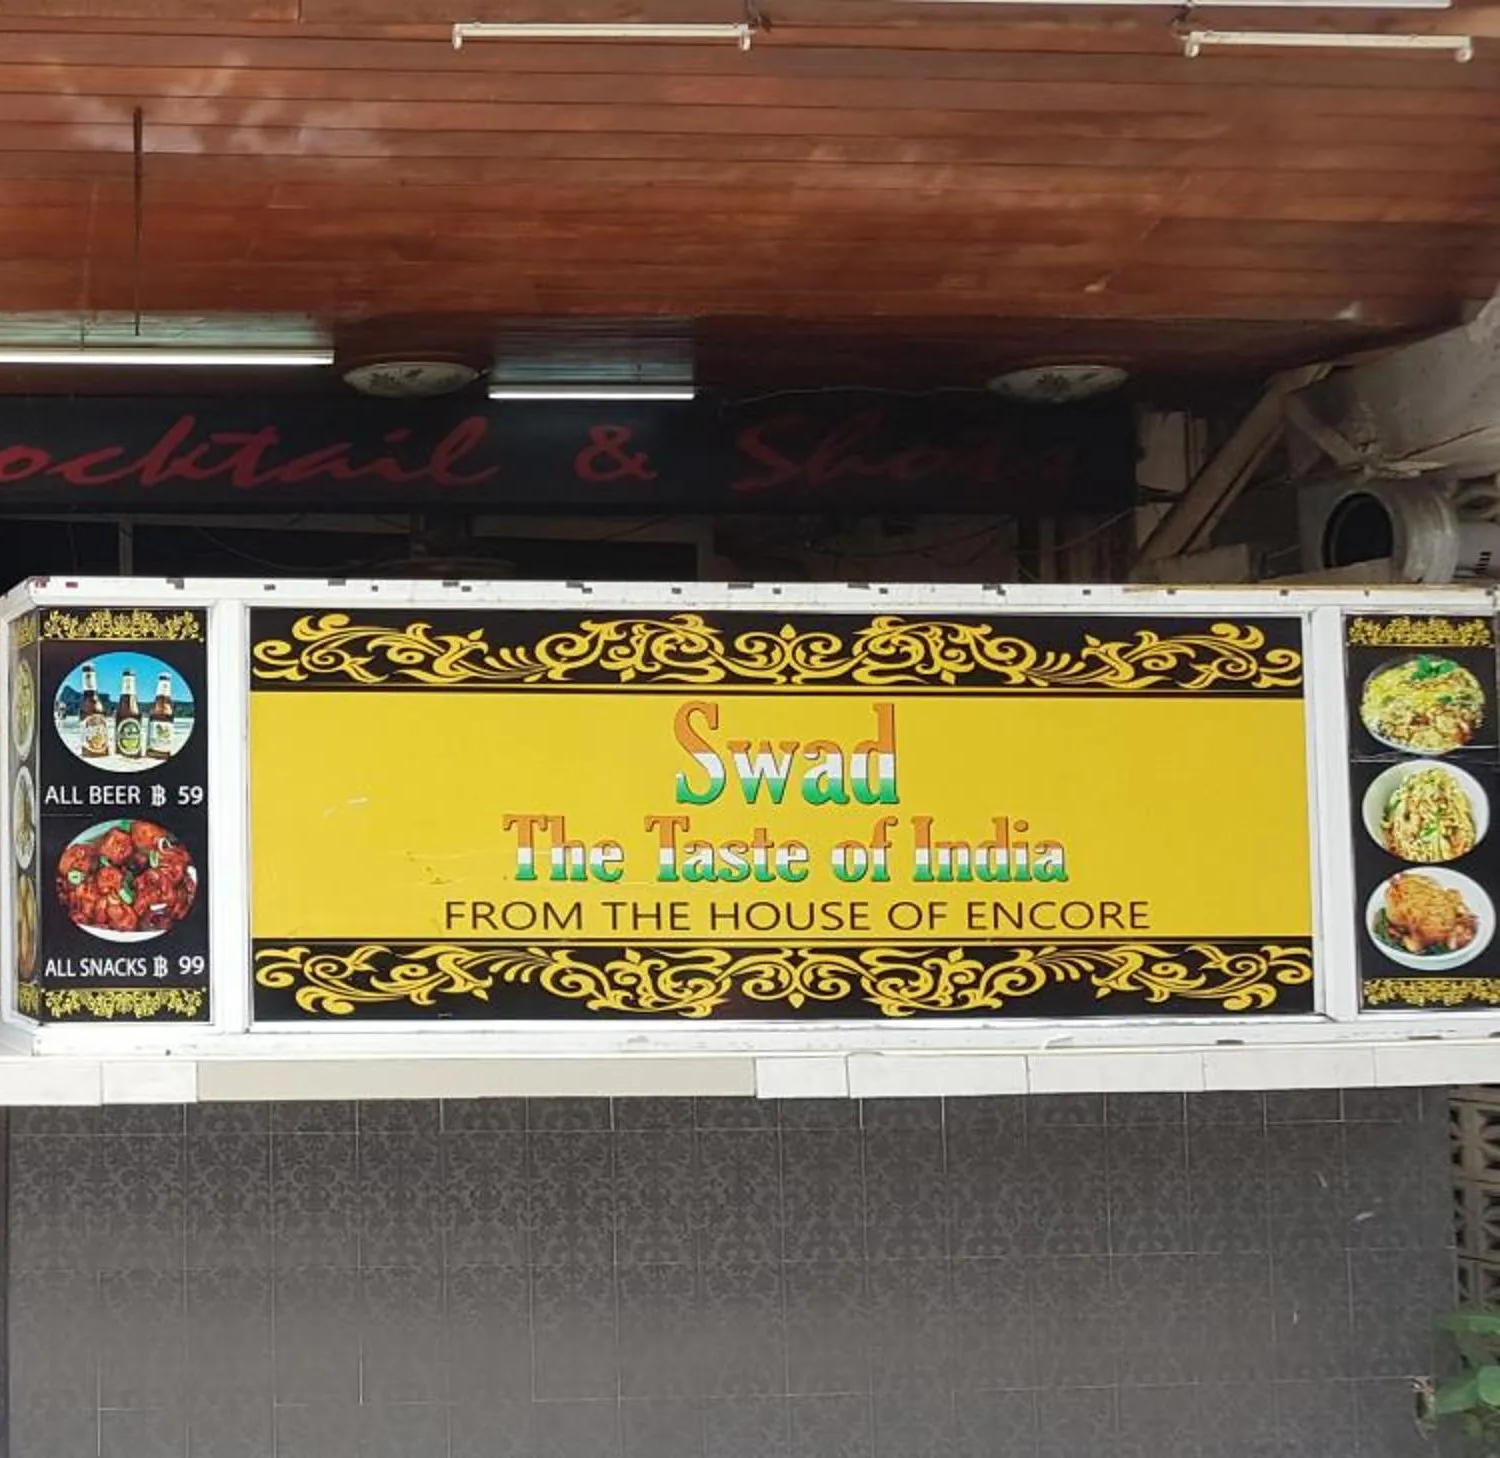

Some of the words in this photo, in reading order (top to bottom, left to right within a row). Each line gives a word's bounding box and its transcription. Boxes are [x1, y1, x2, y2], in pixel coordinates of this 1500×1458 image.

[574, 424, 658, 483] &
[673, 700, 900, 806] Swad
[44, 785, 84, 805] ALL
[89, 785, 141, 805] BEER
[177, 785, 204, 805] 59
[502, 814, 625, 882] The
[644, 814, 809, 883] Taste
[830, 816, 898, 883] of
[912, 815, 1068, 883] India
[445, 901, 583, 931] FROM
[601, 901, 691, 931] THE
[710, 901, 871, 931] HOUSE
[887, 901, 948, 931] OF
[967, 900, 1151, 931] ENCORE
[44, 958, 77, 977] ALL
[79, 957, 148, 978] SNACKS
[178, 955, 205, 975] 99
